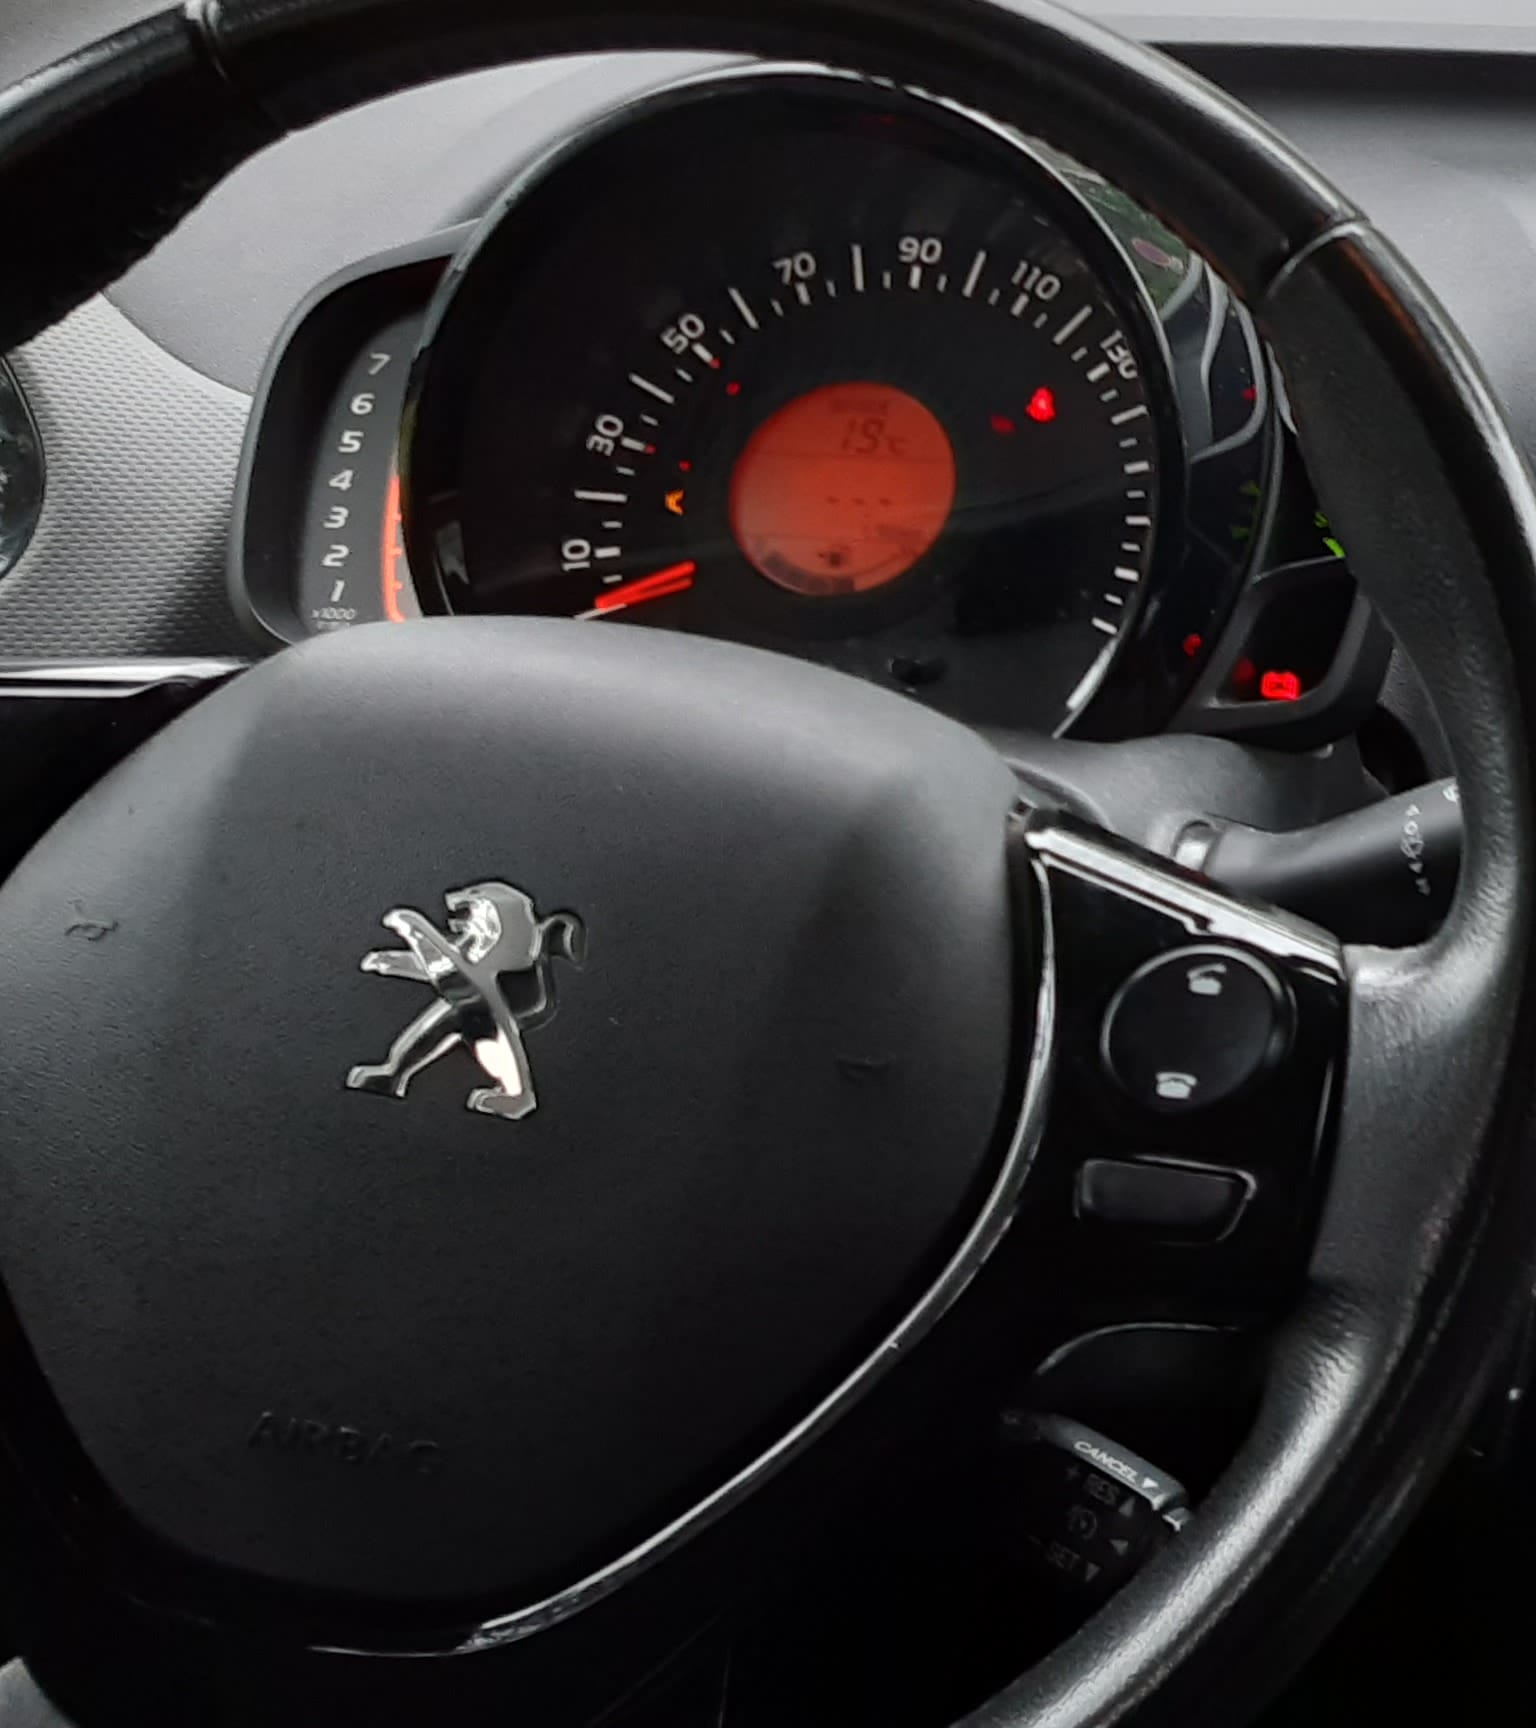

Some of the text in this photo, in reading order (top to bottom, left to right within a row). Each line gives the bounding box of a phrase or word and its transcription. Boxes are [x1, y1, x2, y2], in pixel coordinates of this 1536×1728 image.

[898, 236, 943, 264] 90
[772, 251, 818, 285] 70
[1011, 259, 1061, 301] 110
[660, 313, 705, 355] 50
[368, 352, 391, 375] 7
[350, 392, 375, 415] 6
[338, 430, 364, 454] 5
[586, 413, 625, 457] 30
[329, 469, 354, 491] 4
[323, 505, 350, 529] 3
[321, 543, 350, 568] 2
[562, 538, 591, 572] 10
[330, 579, 345, 603] 1
[1073, 1439, 1139, 1484] CANCEL
